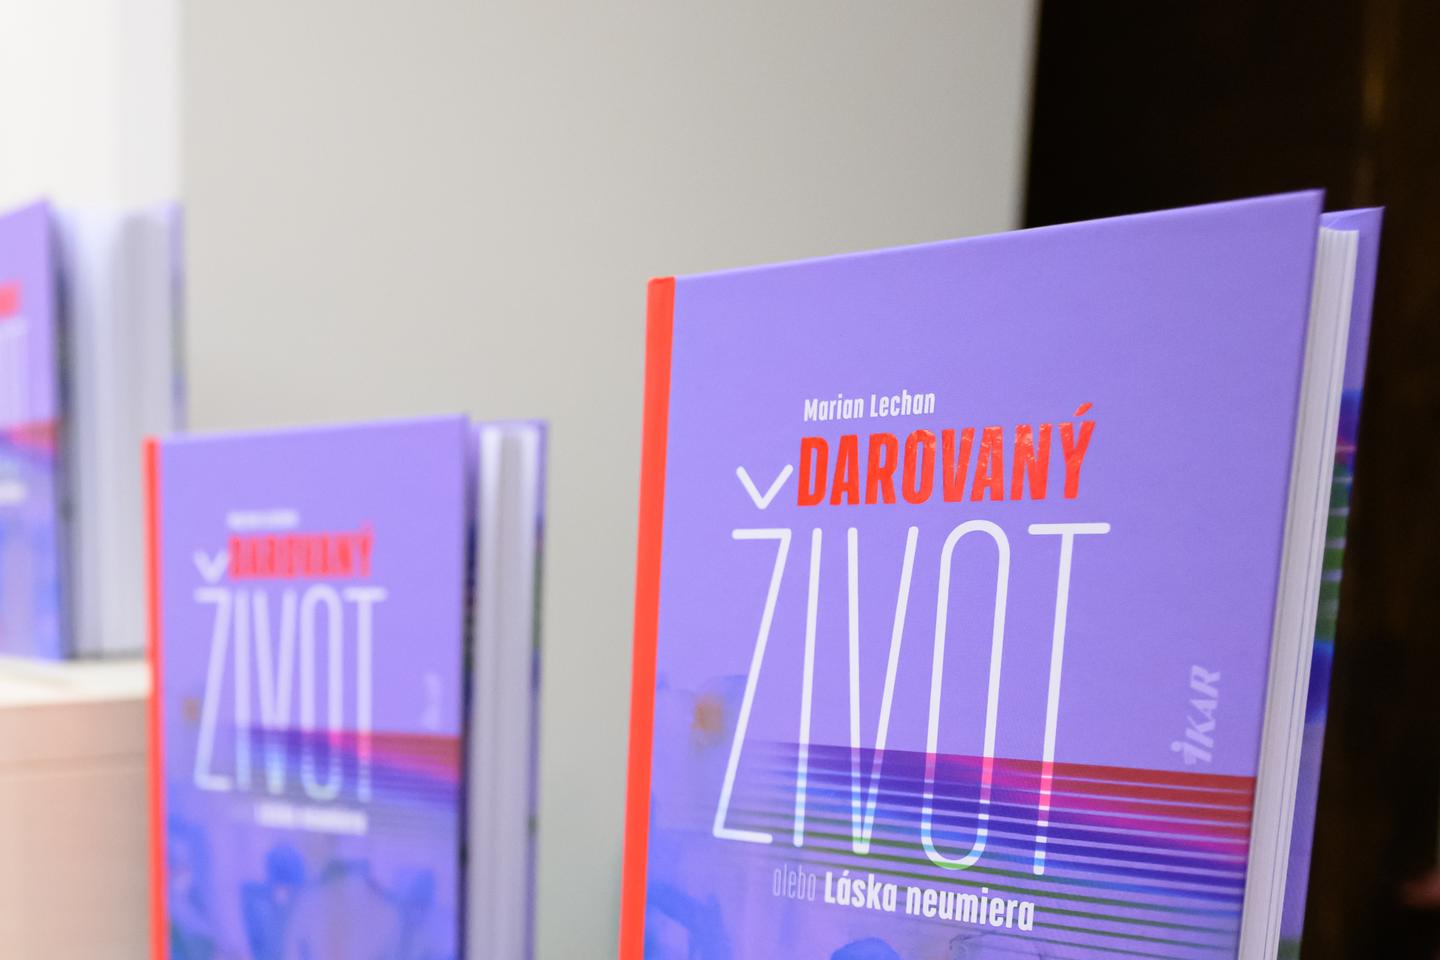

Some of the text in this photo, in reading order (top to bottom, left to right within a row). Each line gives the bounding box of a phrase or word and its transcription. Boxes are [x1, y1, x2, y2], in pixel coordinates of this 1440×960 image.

[797, 402, 1096, 507] DAROVANÝ
[803, 389, 936, 422] Marian Lechan
[193, 549, 389, 803] ŽIVOT
[712, 464, 1112, 876] ŽIVOT
[824, 869, 898, 913] Láska
[905, 886, 1035, 932] neumiera
